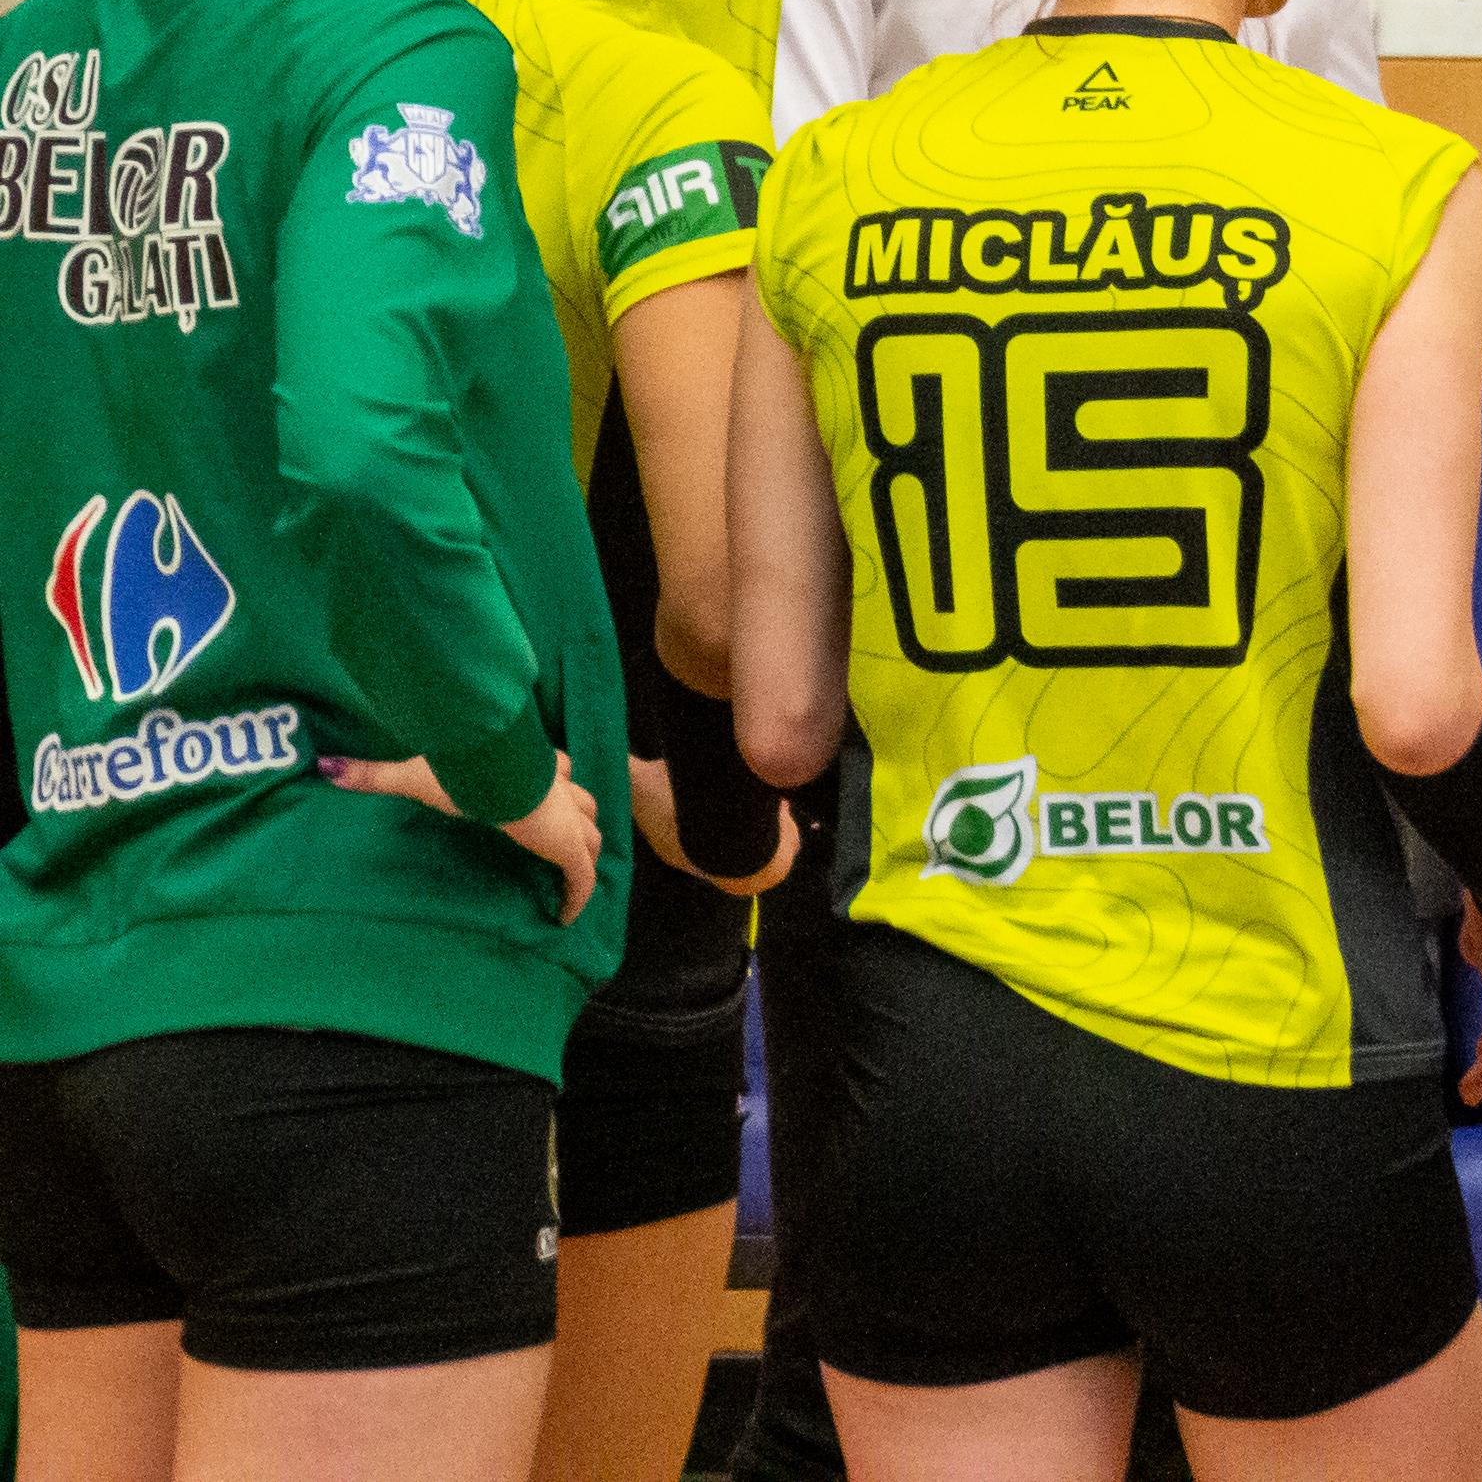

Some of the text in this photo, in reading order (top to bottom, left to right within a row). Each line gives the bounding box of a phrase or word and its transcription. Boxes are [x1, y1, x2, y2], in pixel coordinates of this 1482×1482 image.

[2, 49, 100, 131] CSU
[1061, 94, 1132, 112] PEAK
[846, 192, 1289, 312] MICLĂUȘ
[856, 310, 1270, 673] 15
[36, 709, 293, 807] Carrefour
[1045, 794, 1259, 850] BELOR
